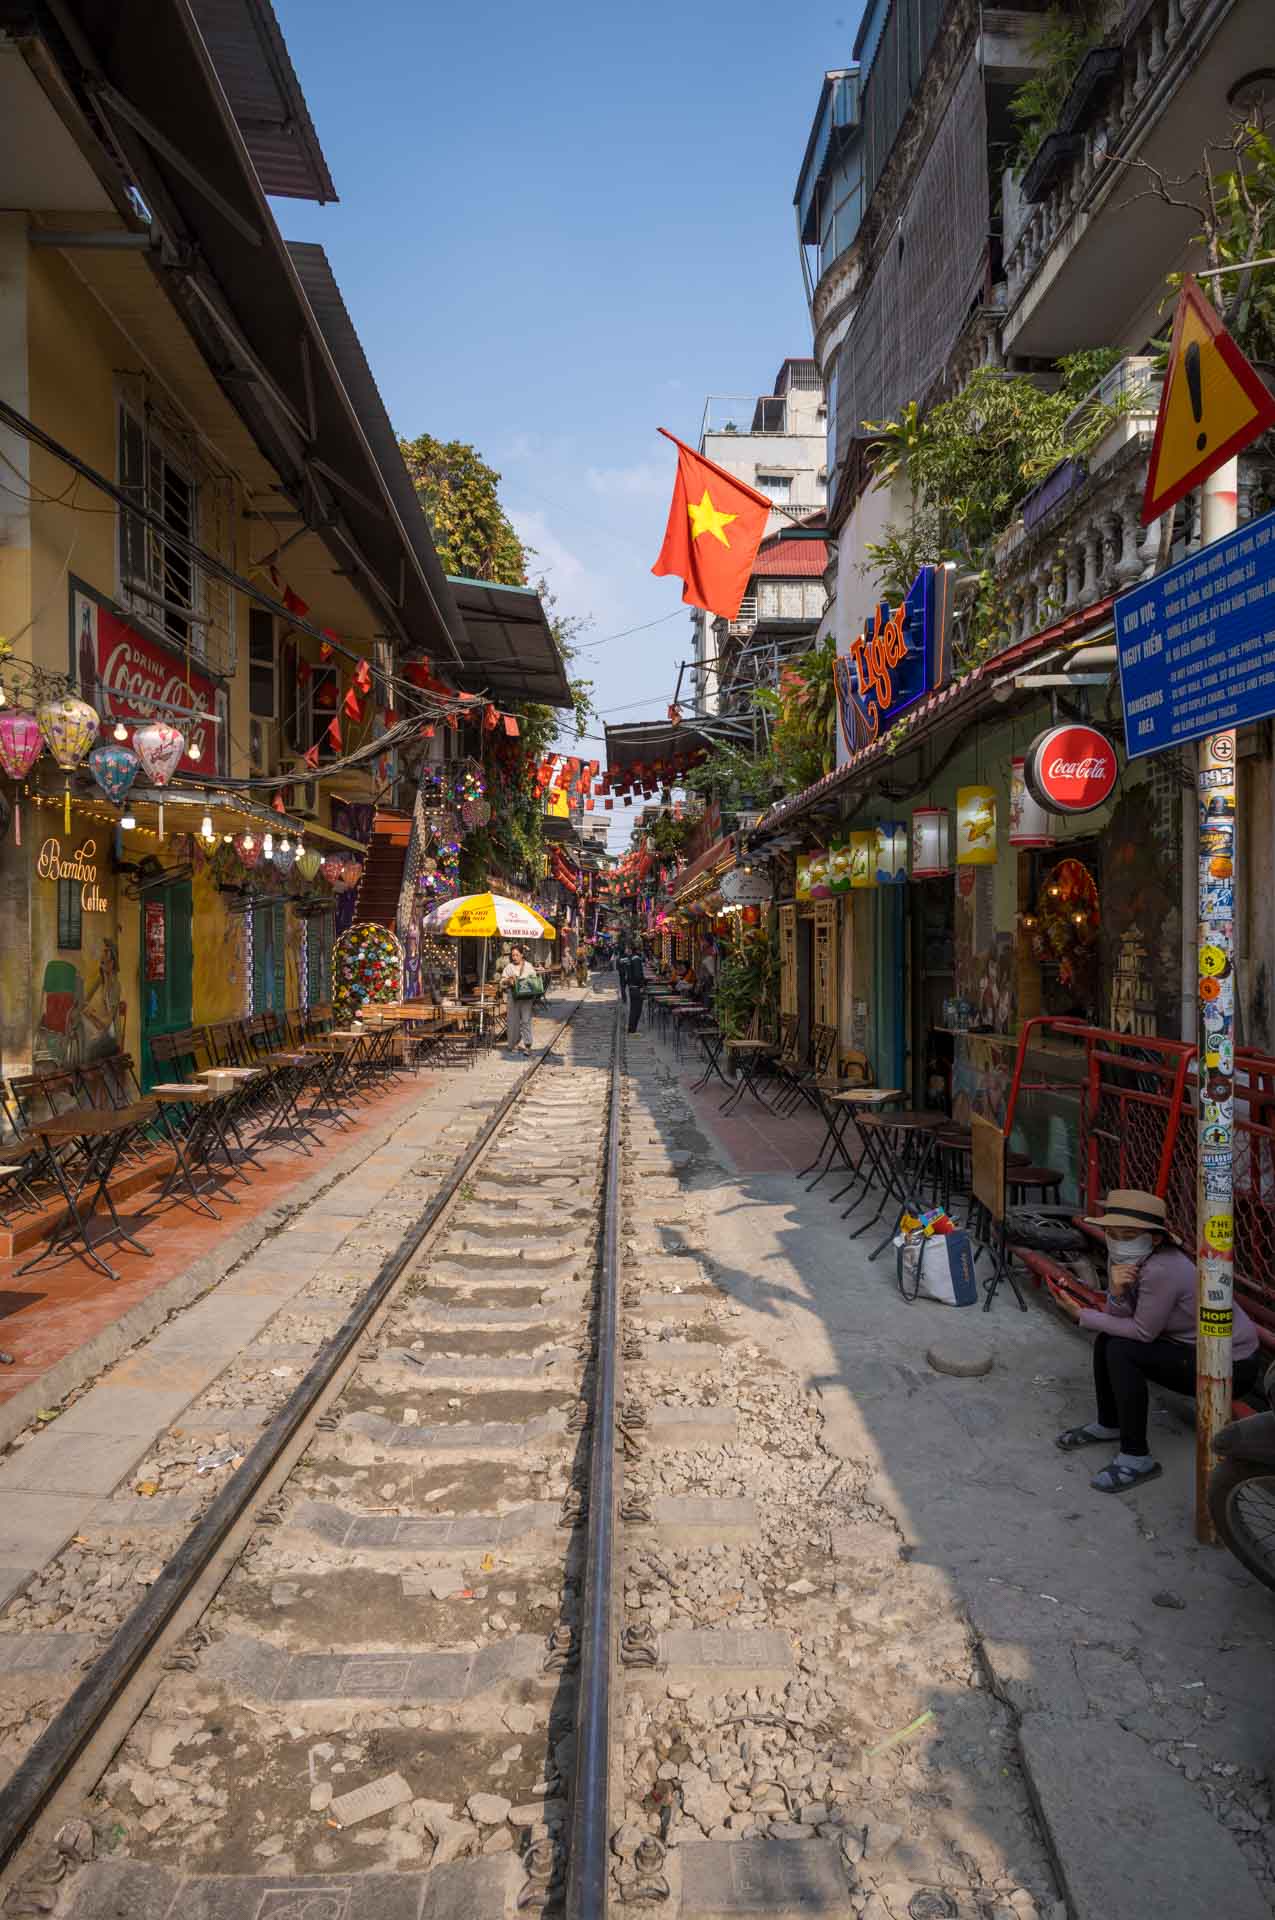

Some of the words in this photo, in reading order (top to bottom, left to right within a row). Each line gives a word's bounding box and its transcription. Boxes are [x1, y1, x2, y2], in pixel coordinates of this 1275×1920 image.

[1123, 610, 1138, 633] KHU
[133, 651, 166, 680] DRINK
[850, 602, 908, 710] Tiger
[1127, 689, 1163, 715] DANGEROUS
[1138, 717, 1153, 734] AREA
[1048, 757, 1106, 780] Coca-Cola
[38, 838, 97, 883] Bamboo
[81, 884, 108, 912] Coffee
[1211, 1219, 1229, 1229] THE
